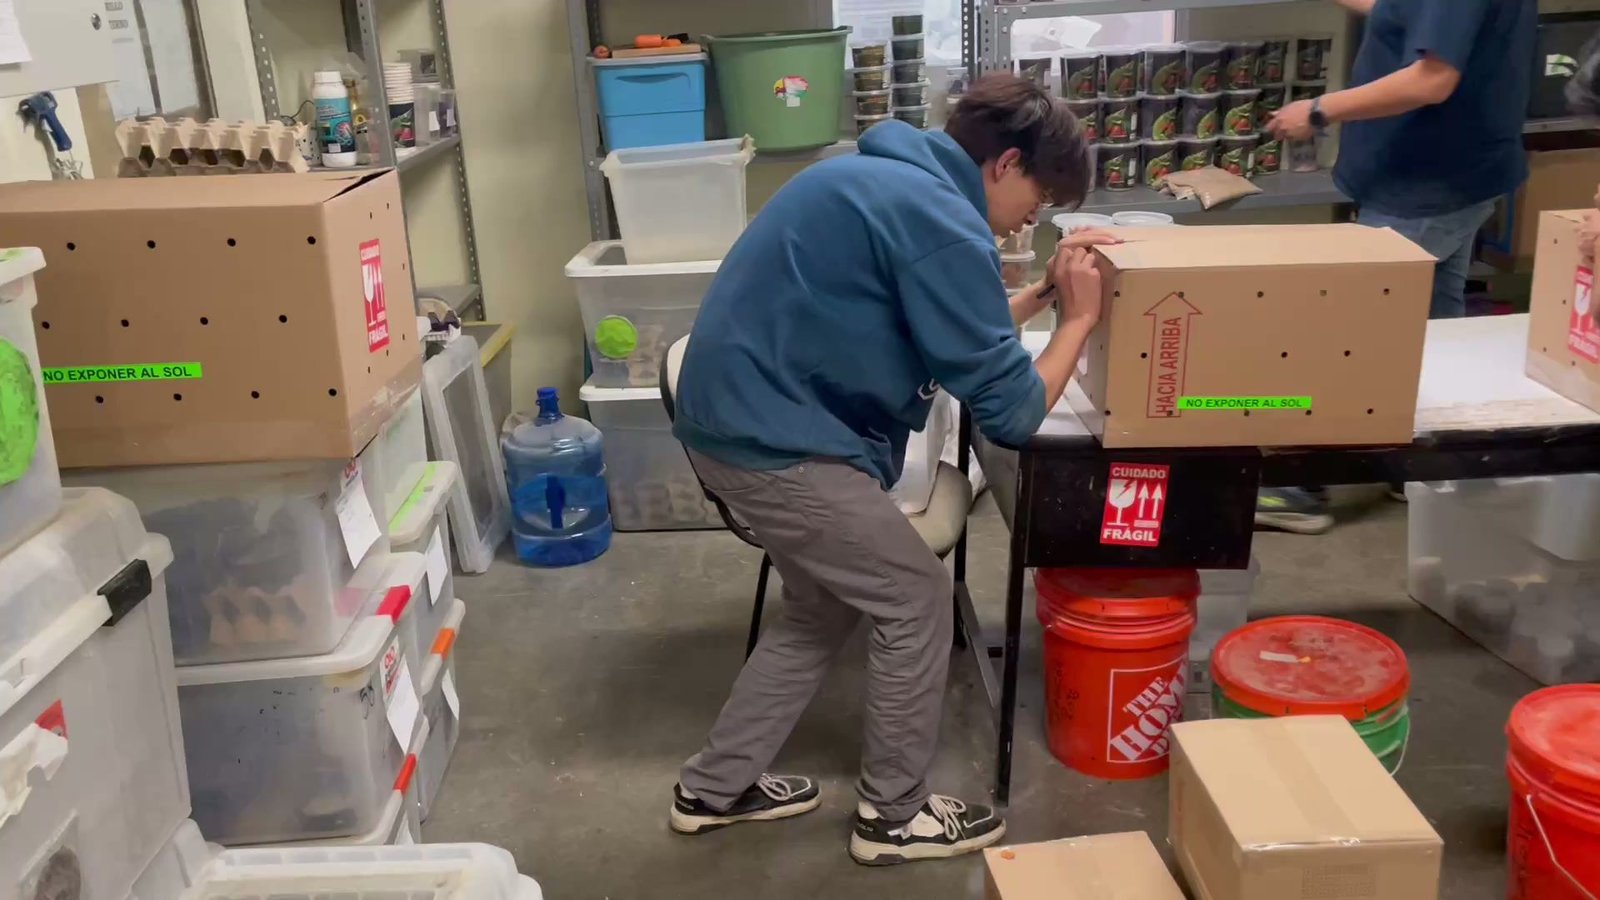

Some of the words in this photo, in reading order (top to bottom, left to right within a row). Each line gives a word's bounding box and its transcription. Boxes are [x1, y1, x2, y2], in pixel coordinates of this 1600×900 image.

[1160, 317, 1182, 369] ARRIBA
[43, 370, 64, 381] NO
[68, 368, 137, 381] EXPONER
[140, 367, 160, 378] AL
[163, 366, 192, 377] SOL
[1156, 372, 1177, 414] HACIA
[1186, 399, 1203, 408] NO
[1205, 399, 1259, 408] EXPONER
[1261, 399, 1277, 408] AL
[1280, 399, 1302, 408] SOL
[1112, 467, 1166, 479] CUIDADO
[1123, 676, 1168, 717] THE
